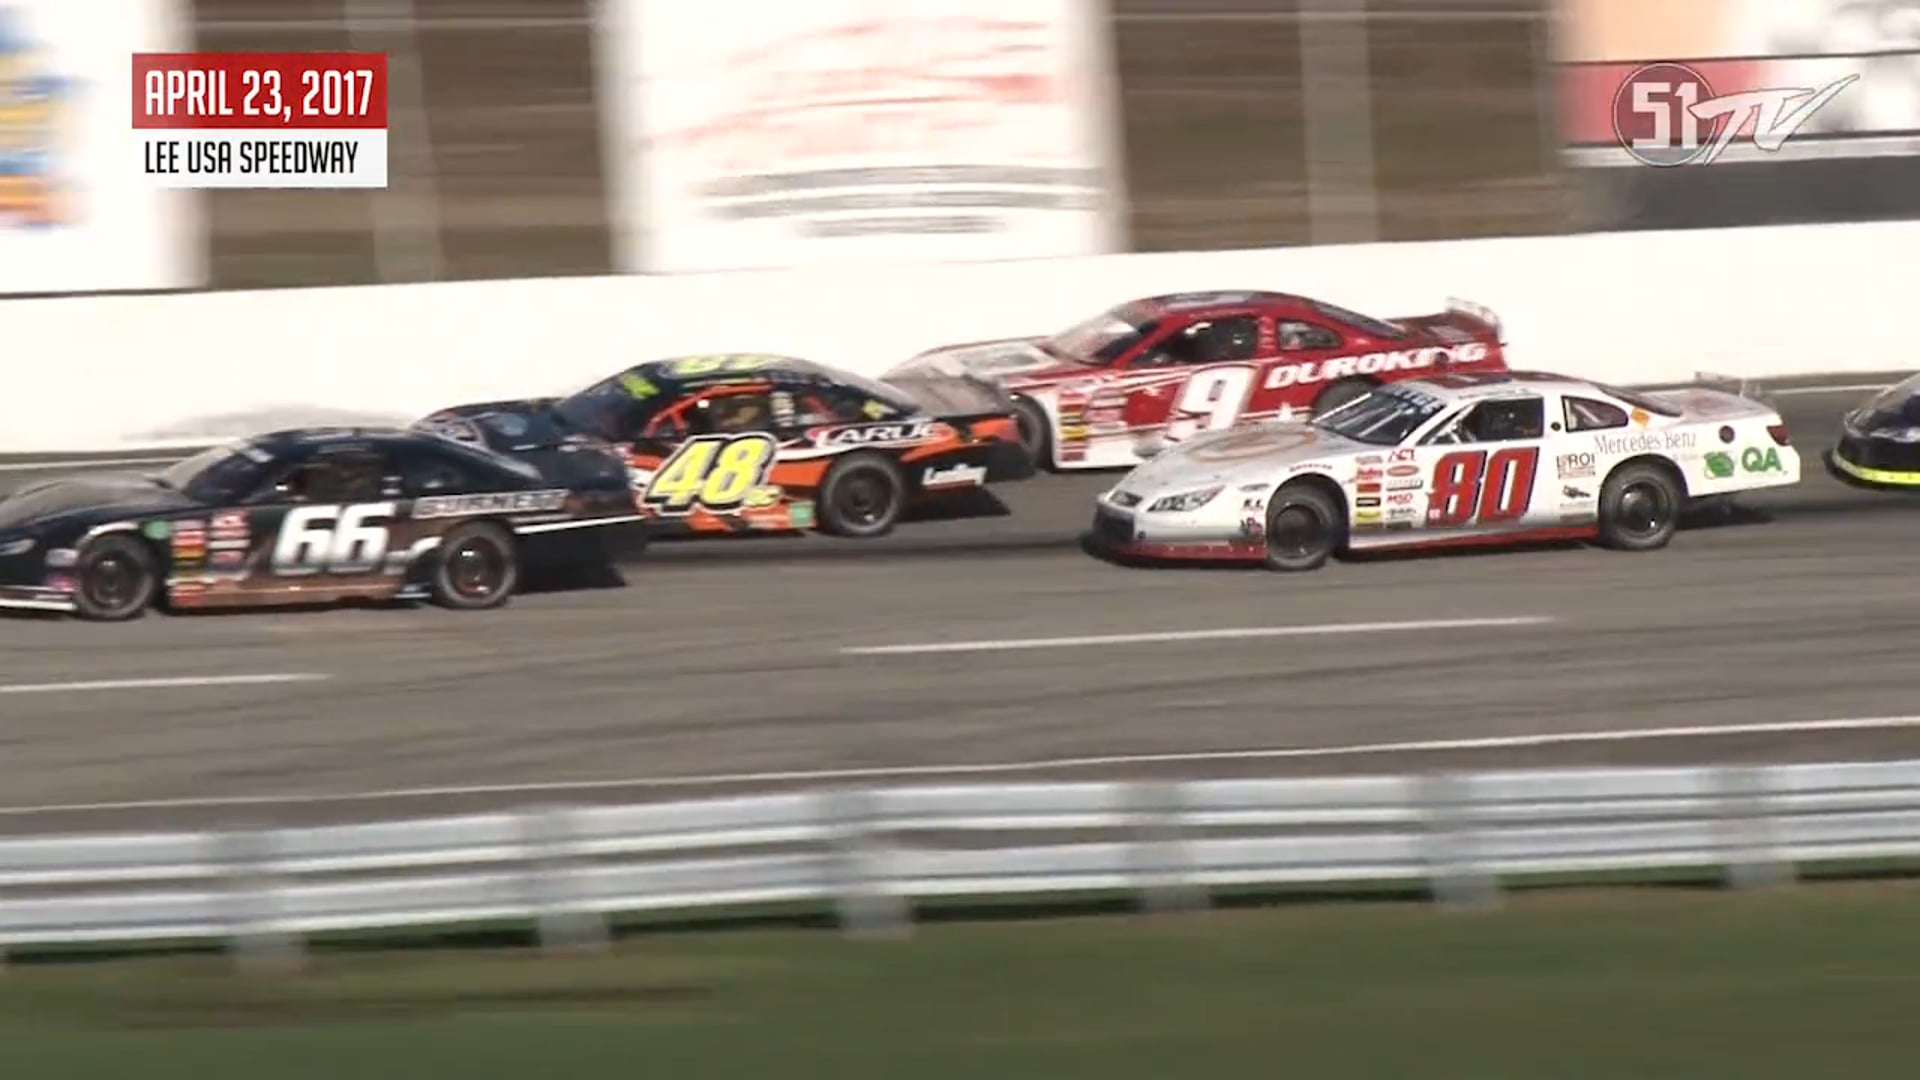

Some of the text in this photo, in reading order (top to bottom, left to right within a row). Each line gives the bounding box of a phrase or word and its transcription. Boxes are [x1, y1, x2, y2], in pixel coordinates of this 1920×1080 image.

[1163, 364, 1260, 442] 9
[643, 431, 777, 517] 48
[1425, 446, 1541, 529] 80
[1741, 446, 1782, 473] QA
[270, 502, 398, 575] 66
